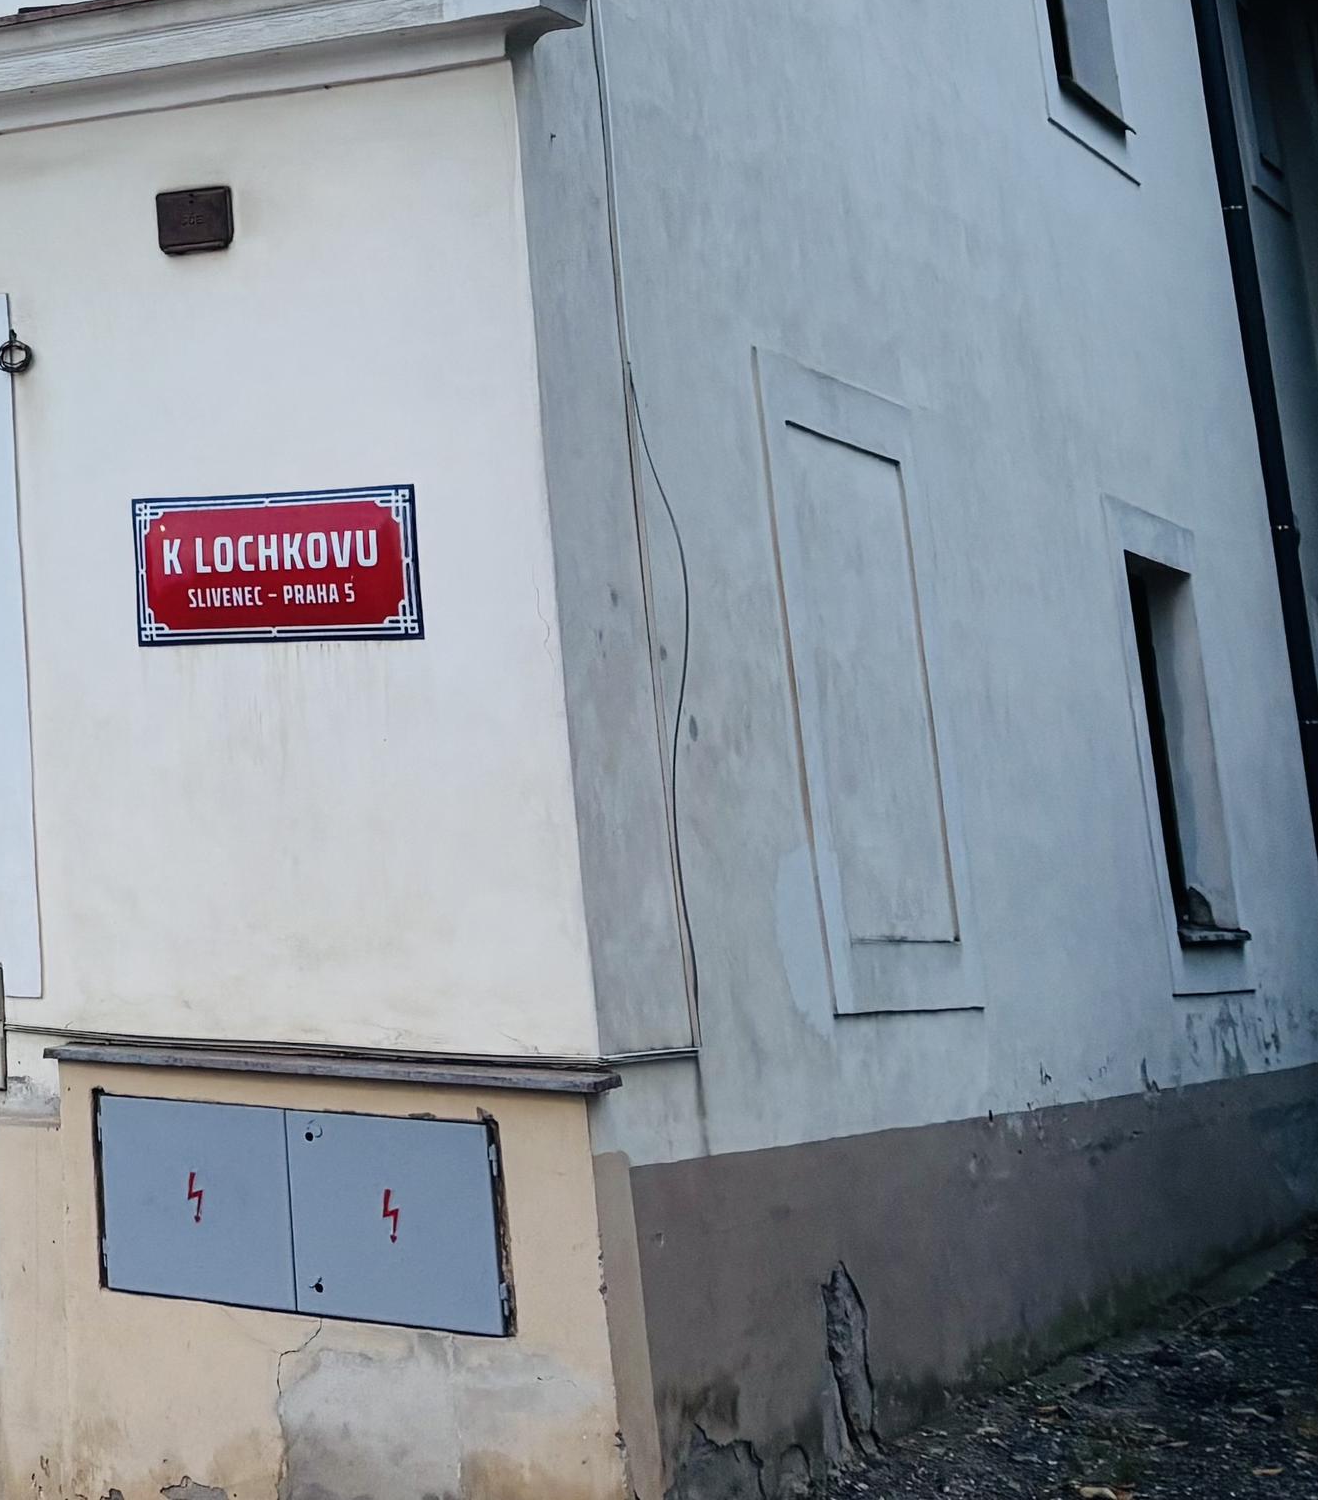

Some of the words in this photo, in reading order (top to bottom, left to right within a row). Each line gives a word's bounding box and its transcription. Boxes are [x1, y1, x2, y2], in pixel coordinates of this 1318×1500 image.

[162, 538, 183, 575] K
[195, 529, 378, 573] LOCHKOVU
[187, 586, 264, 608] SLIVENEC
[283, 583, 340, 605] PRAHA
[344, 582, 355, 603] 5
